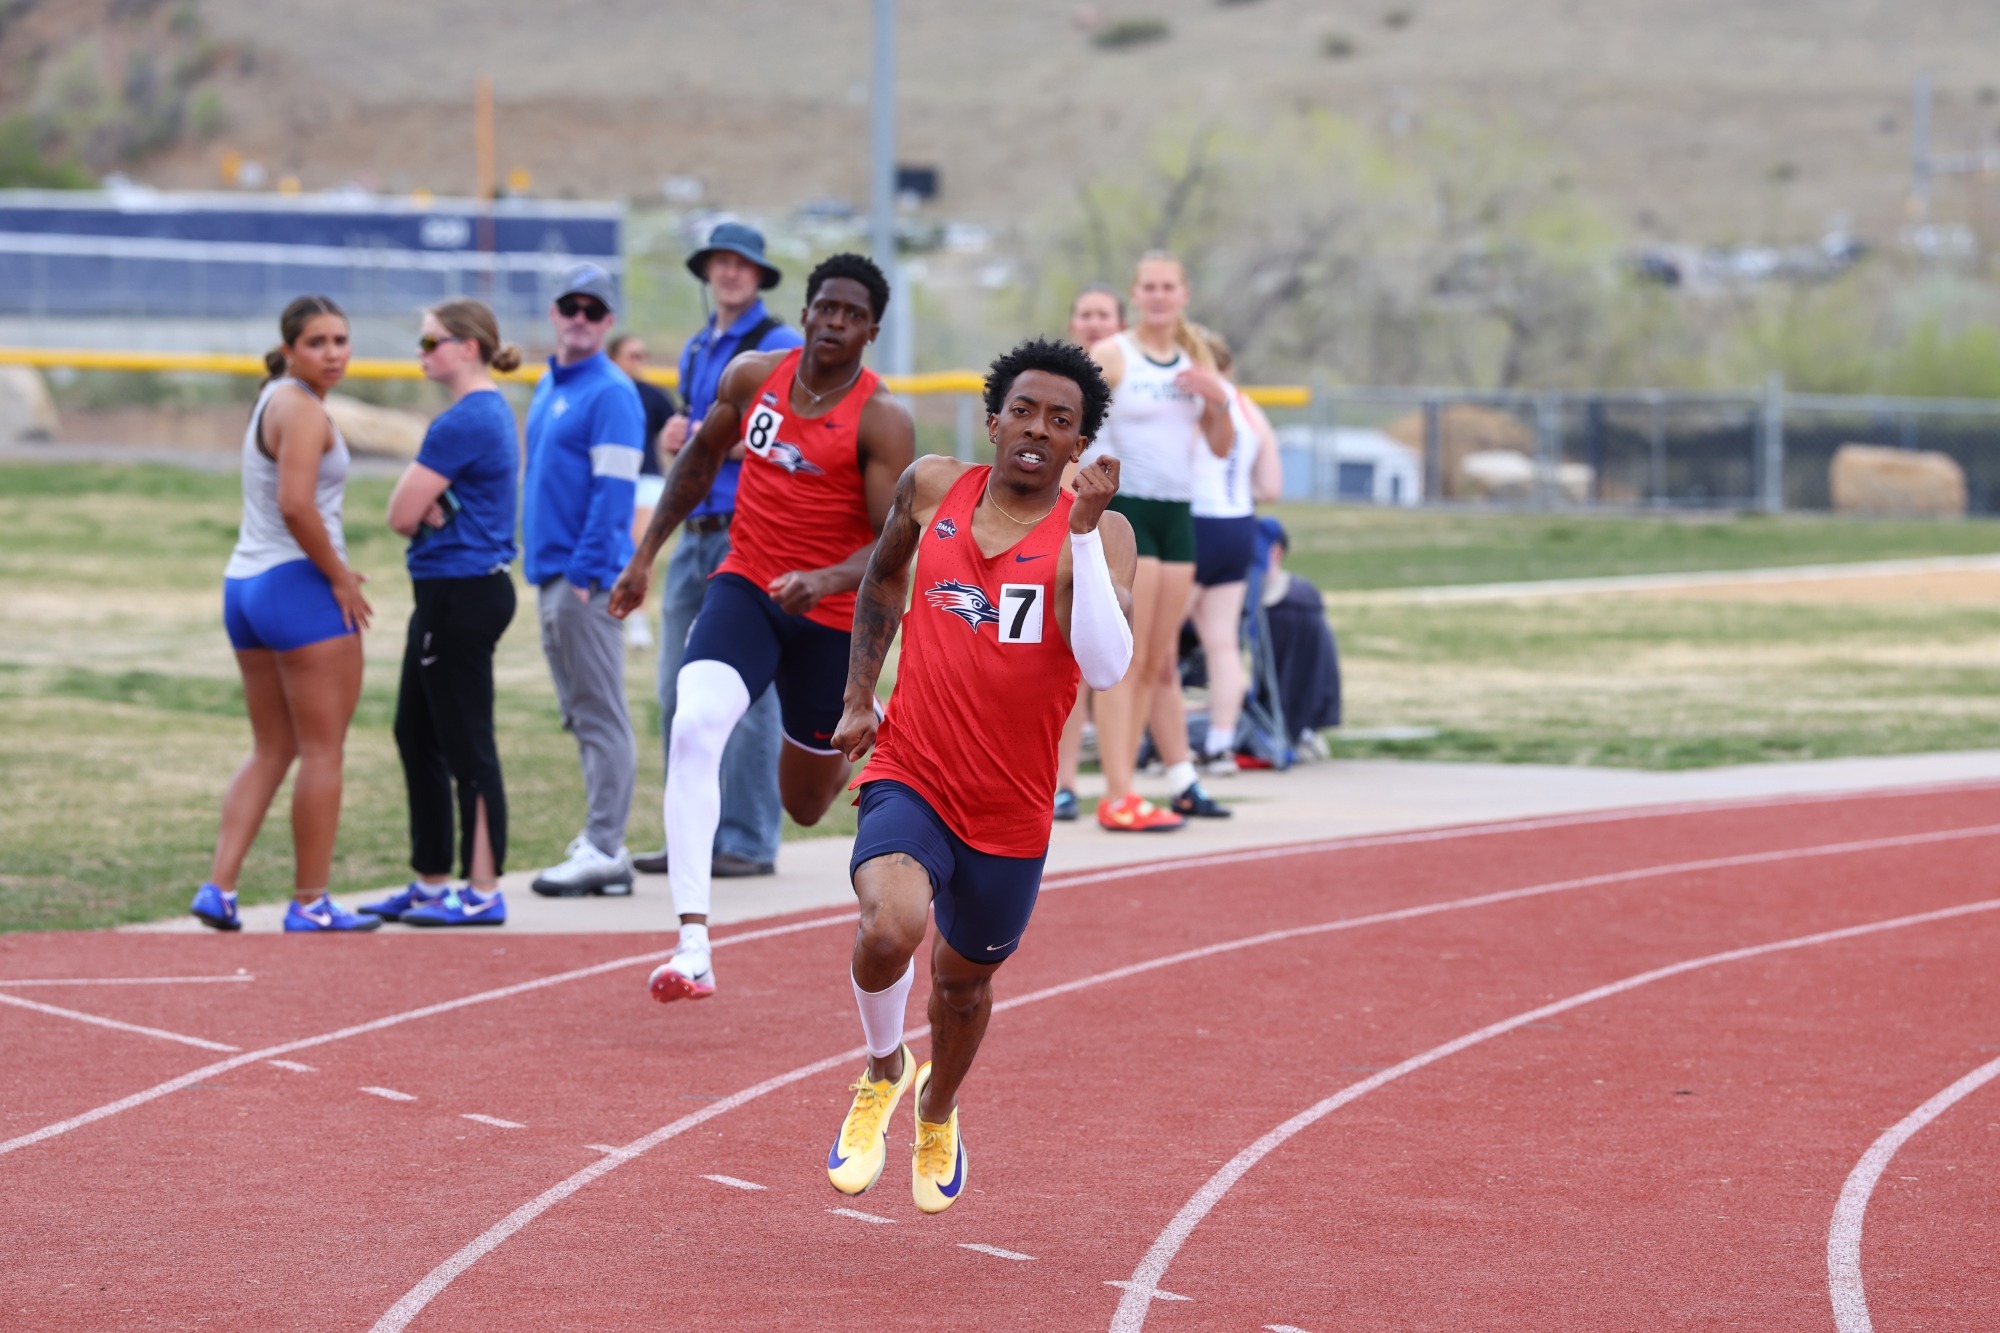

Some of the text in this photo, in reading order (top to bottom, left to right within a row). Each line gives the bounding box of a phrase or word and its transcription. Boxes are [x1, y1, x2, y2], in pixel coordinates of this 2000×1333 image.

[750, 412, 773, 449] 8
[936, 522, 956, 536] RMAC
[1005, 588, 1037, 639] 7
